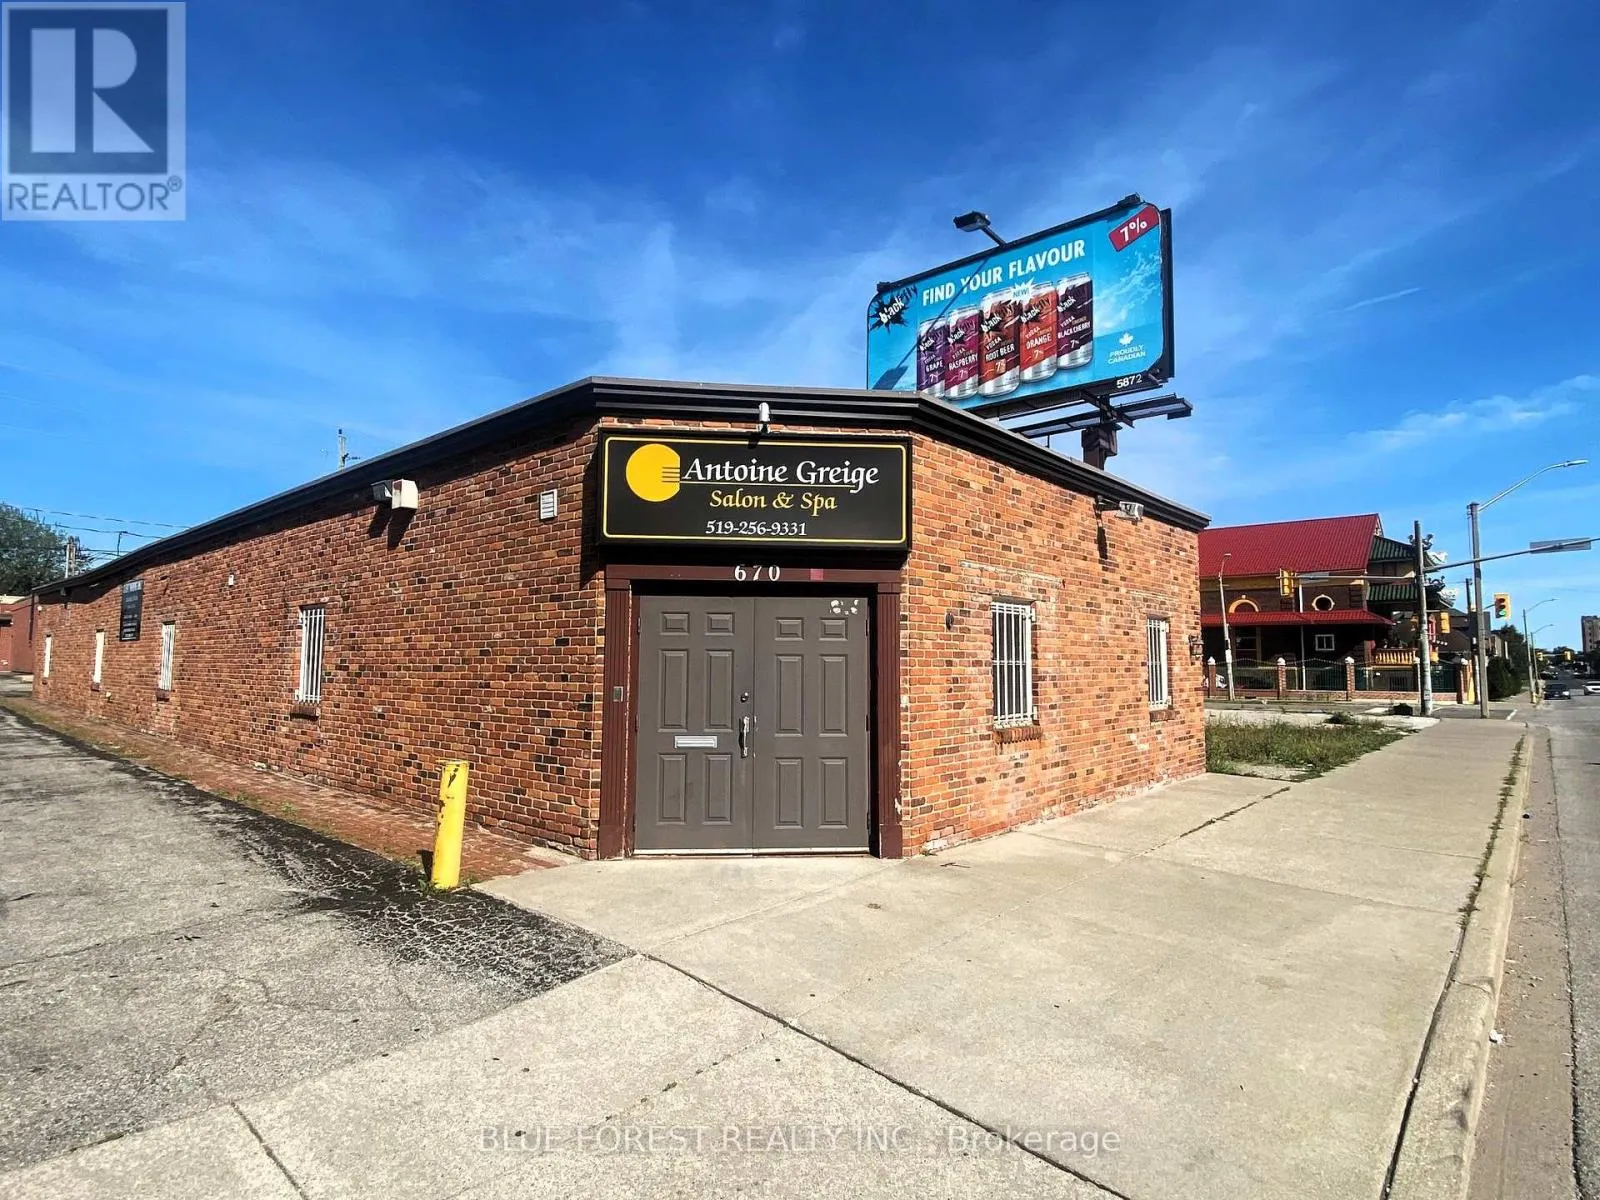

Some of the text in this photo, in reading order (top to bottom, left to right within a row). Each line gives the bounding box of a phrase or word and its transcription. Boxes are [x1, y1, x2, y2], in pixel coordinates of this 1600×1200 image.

[1120, 217, 1148, 242] 7%
[922, 239, 1086, 306] FIND YOUR FLAVOUR
[1058, 327, 1073, 339] BLACK
[1074, 321, 1091, 333] CHERRY
[1026, 333, 1052, 350] ORANGE
[985, 349, 999, 362] ROOT
[1000, 343, 1015, 356] BEER
[1107, 351, 1146, 364] CANADIAN
[1109, 344, 1144, 358] PROUDLY
[926, 360, 944, 372] GRAPE
[948, 353, 978, 371] RASPBERRY
[1116, 373, 1143, 389] 5872
[683, 457, 880, 494] Antoine Greige
[709, 488, 838, 517] Salon & Spa
[705, 520, 808, 536] 519-256-9331
[734, 564, 781, 582] 670
